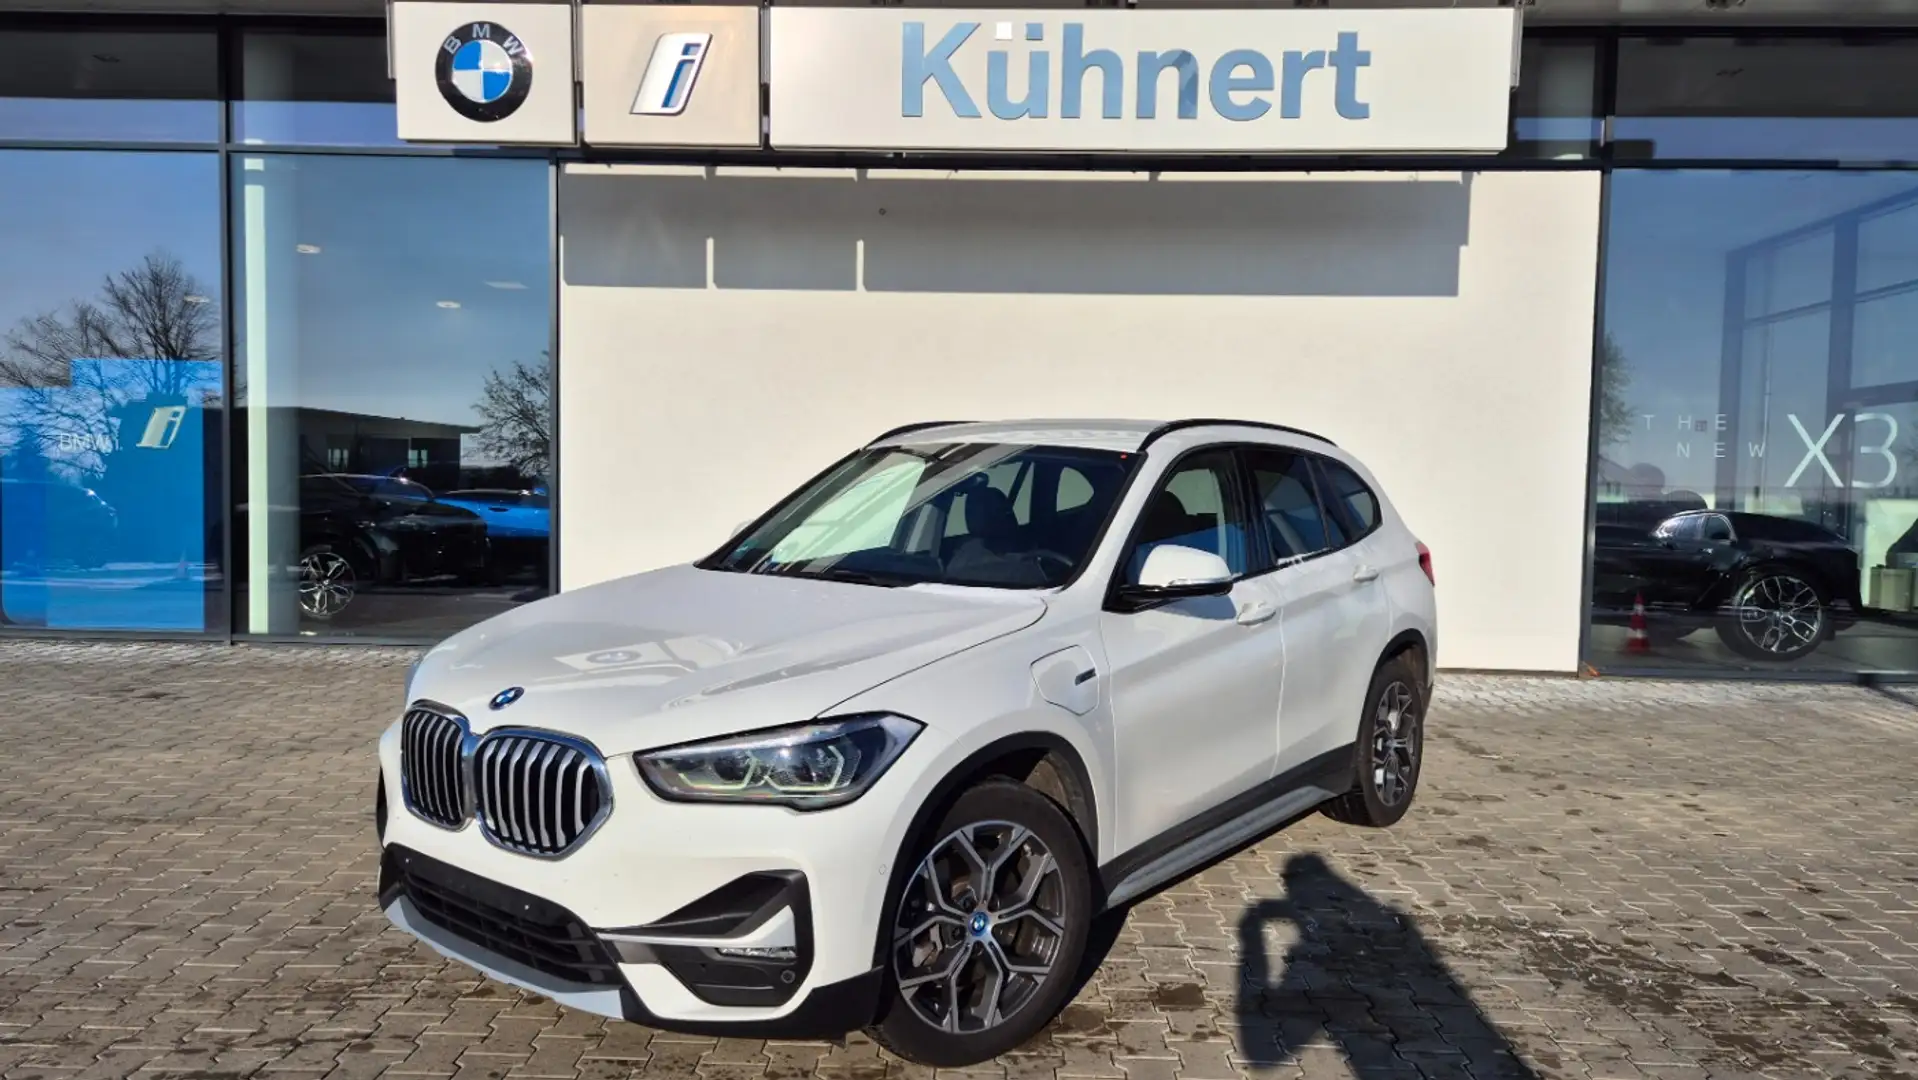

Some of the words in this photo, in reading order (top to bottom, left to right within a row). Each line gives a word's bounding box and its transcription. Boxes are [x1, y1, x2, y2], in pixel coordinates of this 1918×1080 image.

[444, 23, 523, 54] BMW
[901, 22, 1371, 121] Kühnert
[1643, 414, 1727, 431] THE
[1676, 442, 1765, 458] NEW
[1784, 413, 1898, 488] X3
